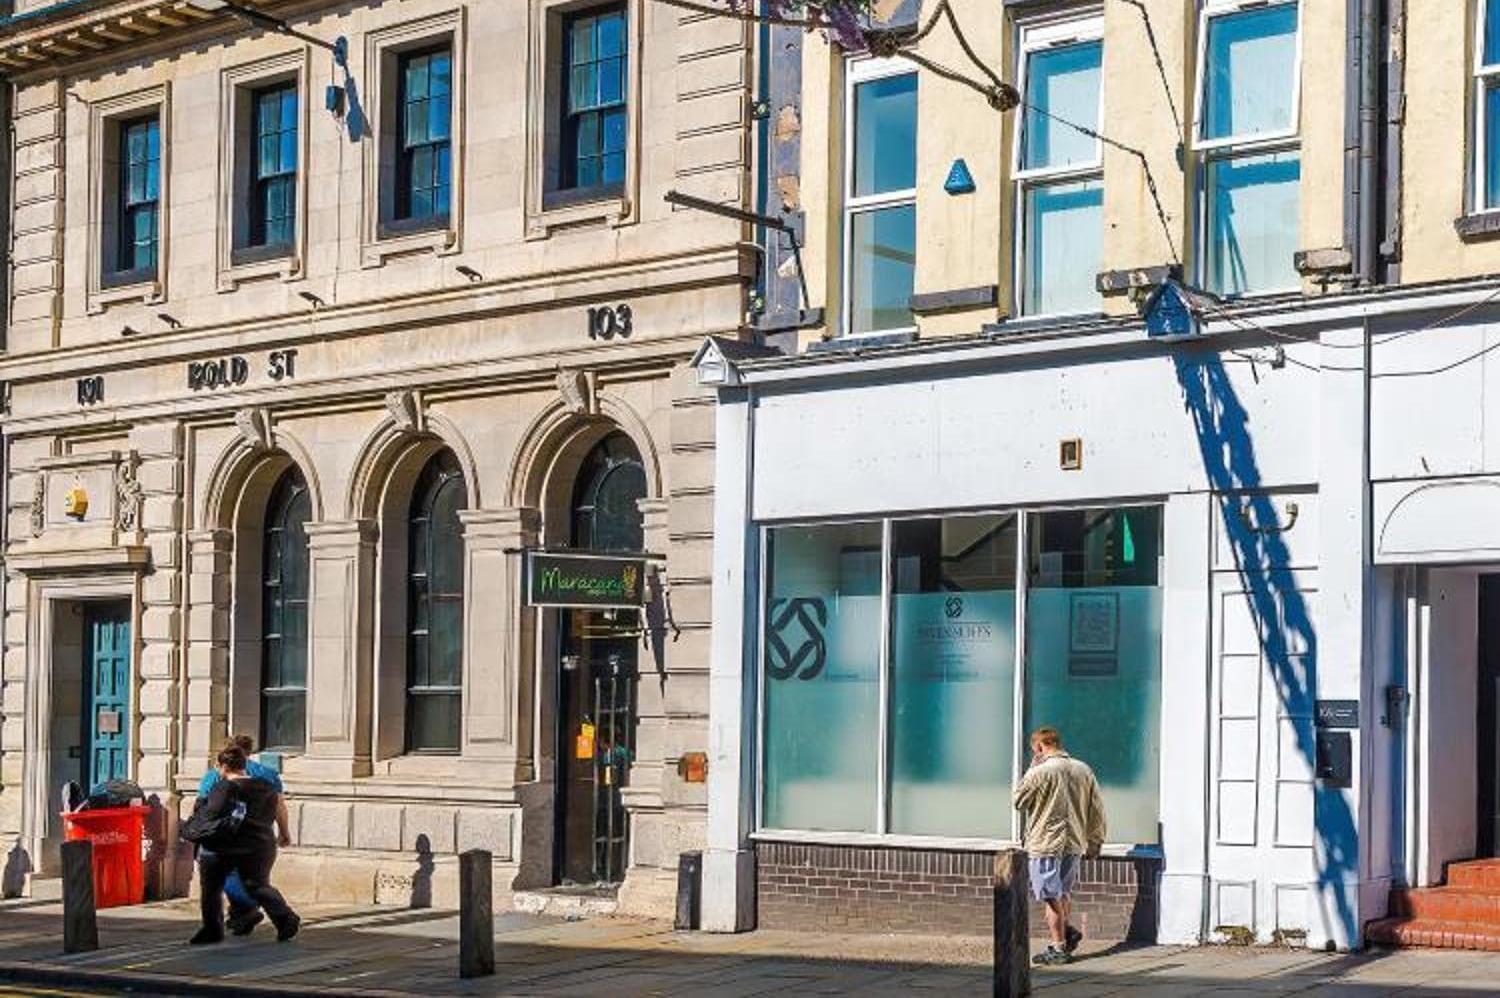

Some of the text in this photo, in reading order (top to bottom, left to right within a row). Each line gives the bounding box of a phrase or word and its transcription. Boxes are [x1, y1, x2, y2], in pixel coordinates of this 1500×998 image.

[588, 304, 632, 340] 103
[187, 349, 298, 391] BOLD ST
[77, 376, 104, 405] 101
